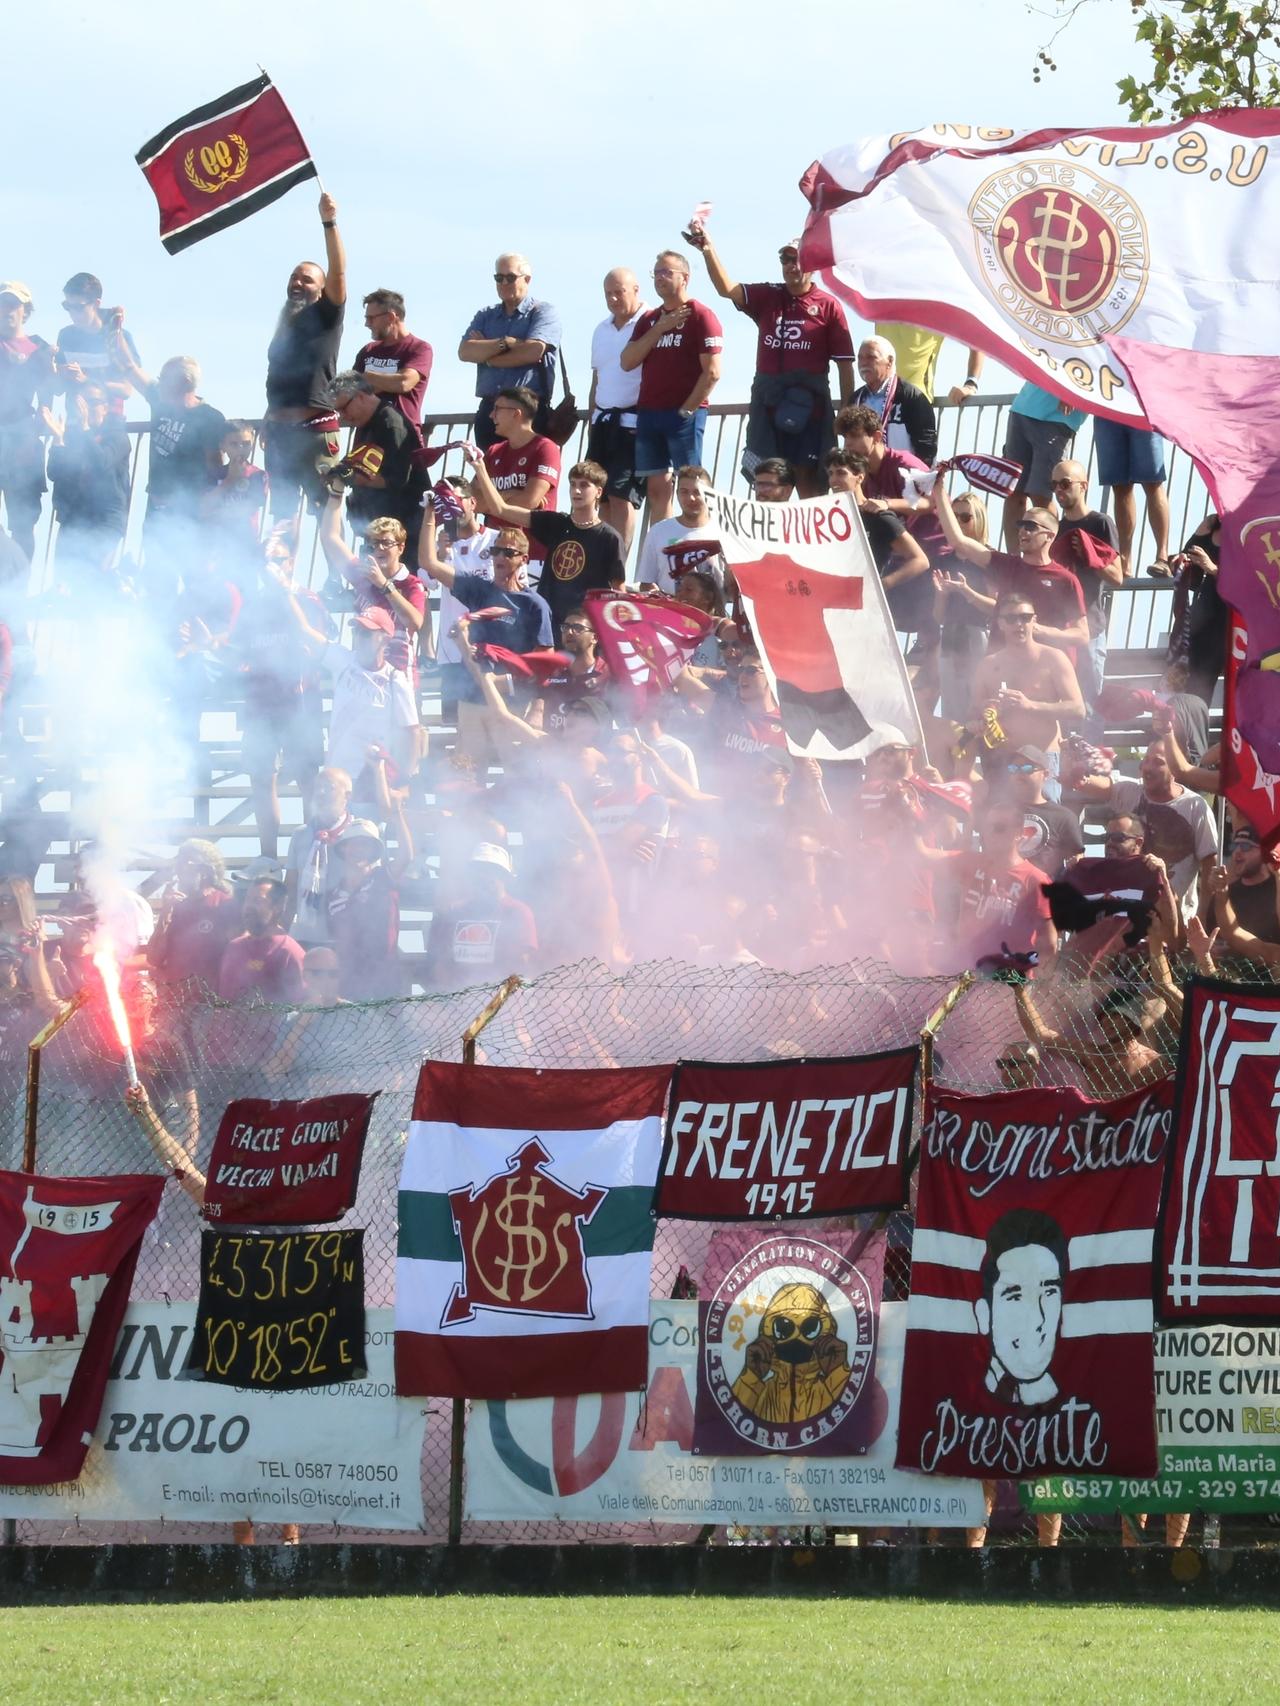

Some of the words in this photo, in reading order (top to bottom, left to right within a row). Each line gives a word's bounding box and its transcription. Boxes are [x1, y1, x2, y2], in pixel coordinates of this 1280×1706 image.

[763, 334, 812, 350] Spnelli
[230, 1123, 286, 1152] FACCE
[664, 1087, 908, 1180] FRENETICI
[960, 1113, 1058, 1198] ogni
[215, 1163, 276, 1188] VECCHI
[744, 1181, 817, 1216] 1915
[38, 1206, 57, 1227] 19
[82, 1209, 100, 1229] 15
[709, 1297, 724, 1337] NEW
[726, 1244, 816, 1293] GENERATION
[821, 1256, 854, 1286] OLD
[850, 1288, 870, 1344] STYLE
[339, 1340, 353, 1365] E
[709, 1351, 789, 1449] LEGHORN
[800, 1351, 868, 1444] CASUAL
[104, 1412, 251, 1454] PAOLO
[1179, 1408, 1234, 1434] CON
[921, 1397, 1108, 1475] Presente
[258, 1461, 291, 1479] TEL
[295, 1462, 333, 1479] 0587
[338, 1464, 399, 1482] 748050
[667, 1465, 686, 1481] Tel
[689, 1466, 717, 1482] 0571
[721, 1466, 755, 1483] 31071
[784, 1467, 804, 1485] Fax
[807, 1468, 835, 1485] 0571
[840, 1469, 887, 1485] 382194
[1165, 1454, 1213, 1472] Santa
[1218, 1454, 1276, 1472] Maria
[162, 1484, 216, 1504] E-mail:
[220, 1487, 401, 1509] martinoils@tiscalinet.it
[1020, 1480, 1058, 1498] Tel.
[1062, 1480, 1114, 1498] 0587
[1120, 1480, 1183, 1498] 704147
[1199, 1480, 1237, 1498] 329
[597, 1493, 629, 1511] Viale
[632, 1494, 659, 1511] delle
[748, 1495, 765, 1512] 2/4
[775, 1497, 811, 1512] 56022
[813, 1497, 917, 1513] CASTELFRANCO
[920, 1498, 933, 1513] DI
[934, 1498, 945, 1513] S.
[947, 1499, 968, 1518] (PI)
